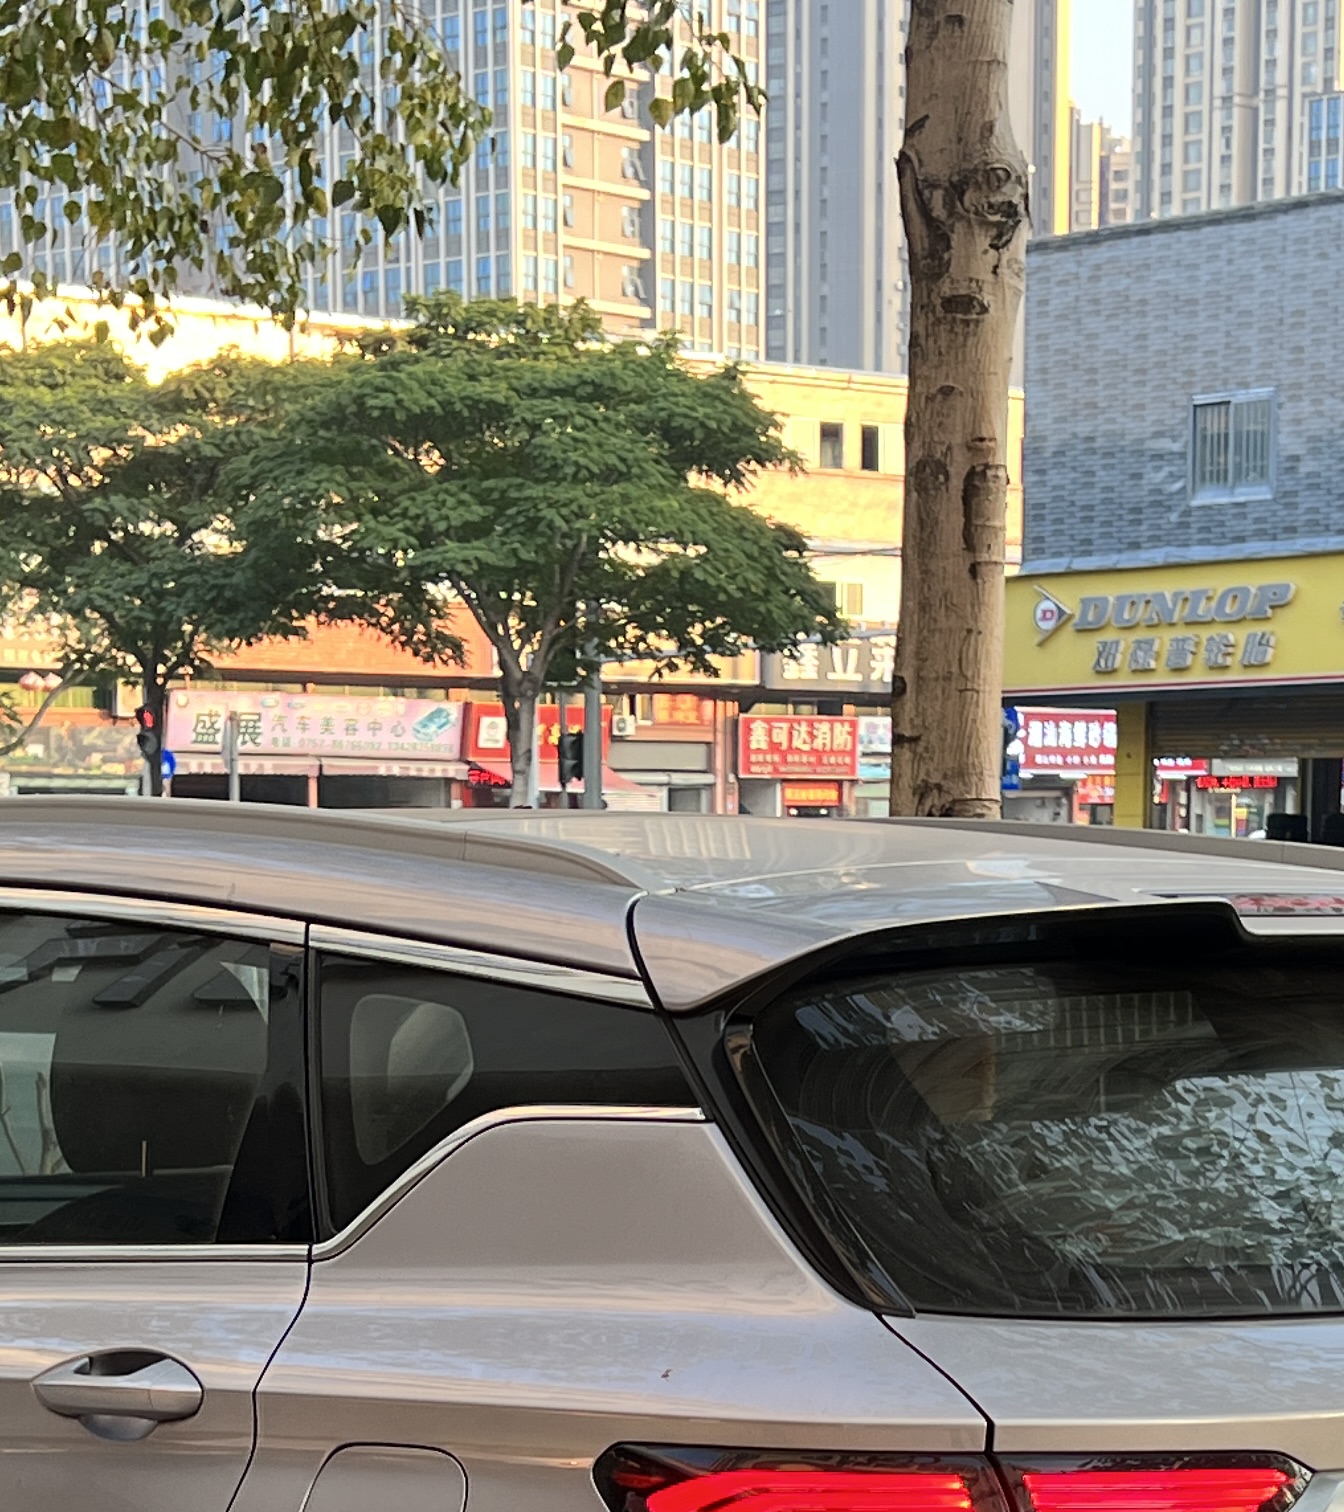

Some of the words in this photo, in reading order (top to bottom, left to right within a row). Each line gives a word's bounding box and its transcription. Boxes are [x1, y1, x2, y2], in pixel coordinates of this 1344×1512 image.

[1072, 582, 1296, 632] DUNLOP
[1093, 631, 1276, 673] 邓禄普轮胎
[271, 713, 407, 738] 汽车美容中心
[749, 719, 854, 752] 鑫可达消防
